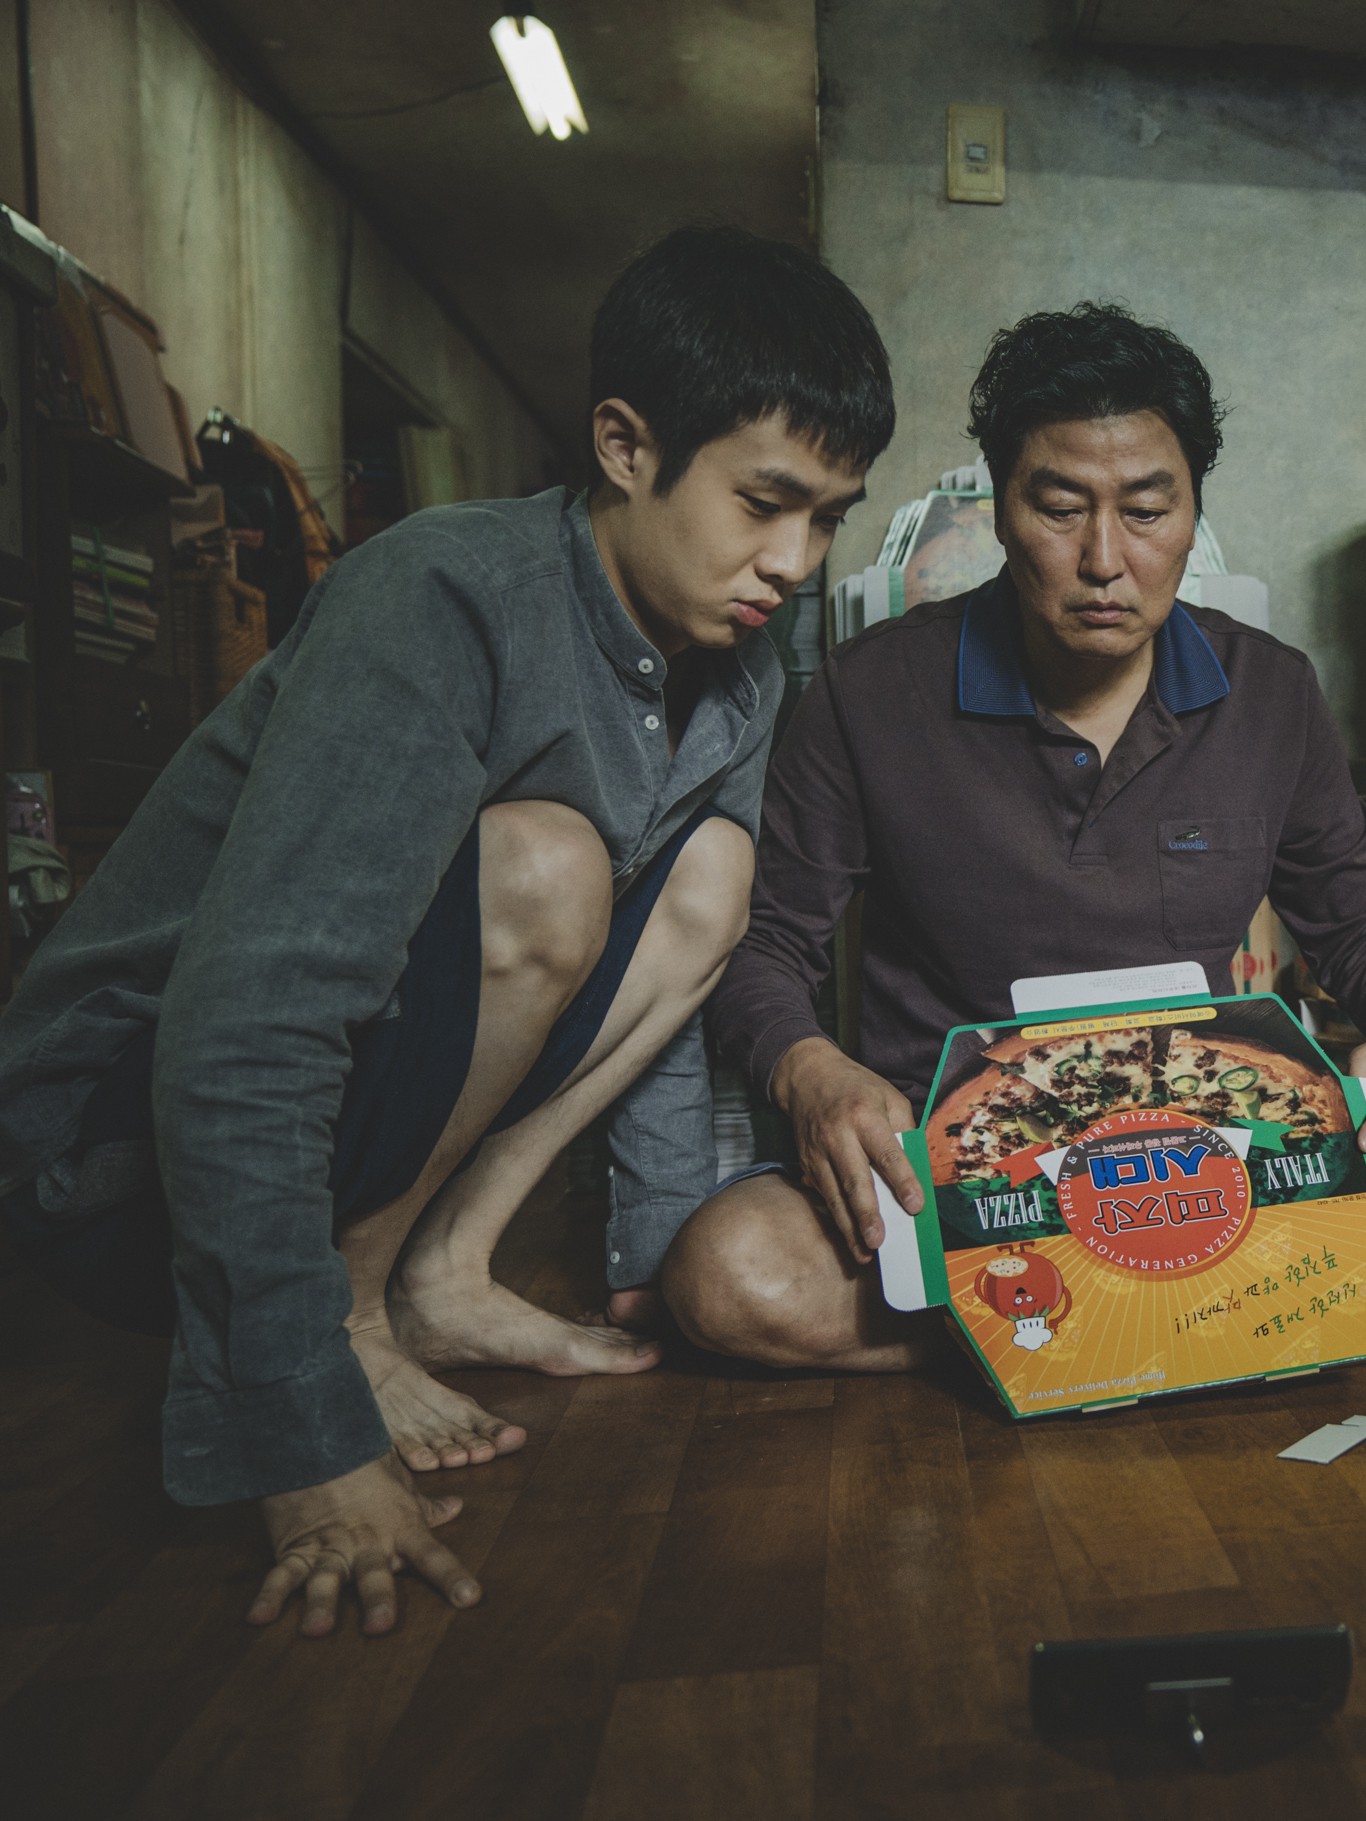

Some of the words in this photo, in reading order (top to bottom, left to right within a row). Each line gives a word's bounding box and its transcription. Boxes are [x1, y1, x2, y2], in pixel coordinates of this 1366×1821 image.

[1168, 839, 1209, 850] Crocodile
[1060, 1171, 1078, 1219] FRESH
[1076, 1121, 1113, 1150] PURE
[1120, 1112, 1170, 1125] PIZZA
[1087, 1143, 1211, 1191] 시대
[1193, 1123, 1235, 1160] SINCE
[1231, 1166, 1246, 1198] 2010
[1263, 1152, 1330, 1190] ITALY
[975, 1190, 1045, 1230] PIZZA
[1091, 1188, 1230, 1236] 피자
[1086, 1235, 1198, 1270] GENERATION
[1203, 1216, 1241, 1255] PIZZA
[1284, 1245, 1338, 1287] 푸짐한
[1309, 1282, 1357, 1318] 신선한
[1027, 1387, 1065, 1400] Service
[1068, 1380, 1109, 1393] Delivery
[1111, 1375, 1137, 1387] Pizza
[1139, 1369, 1166, 1382] Home
